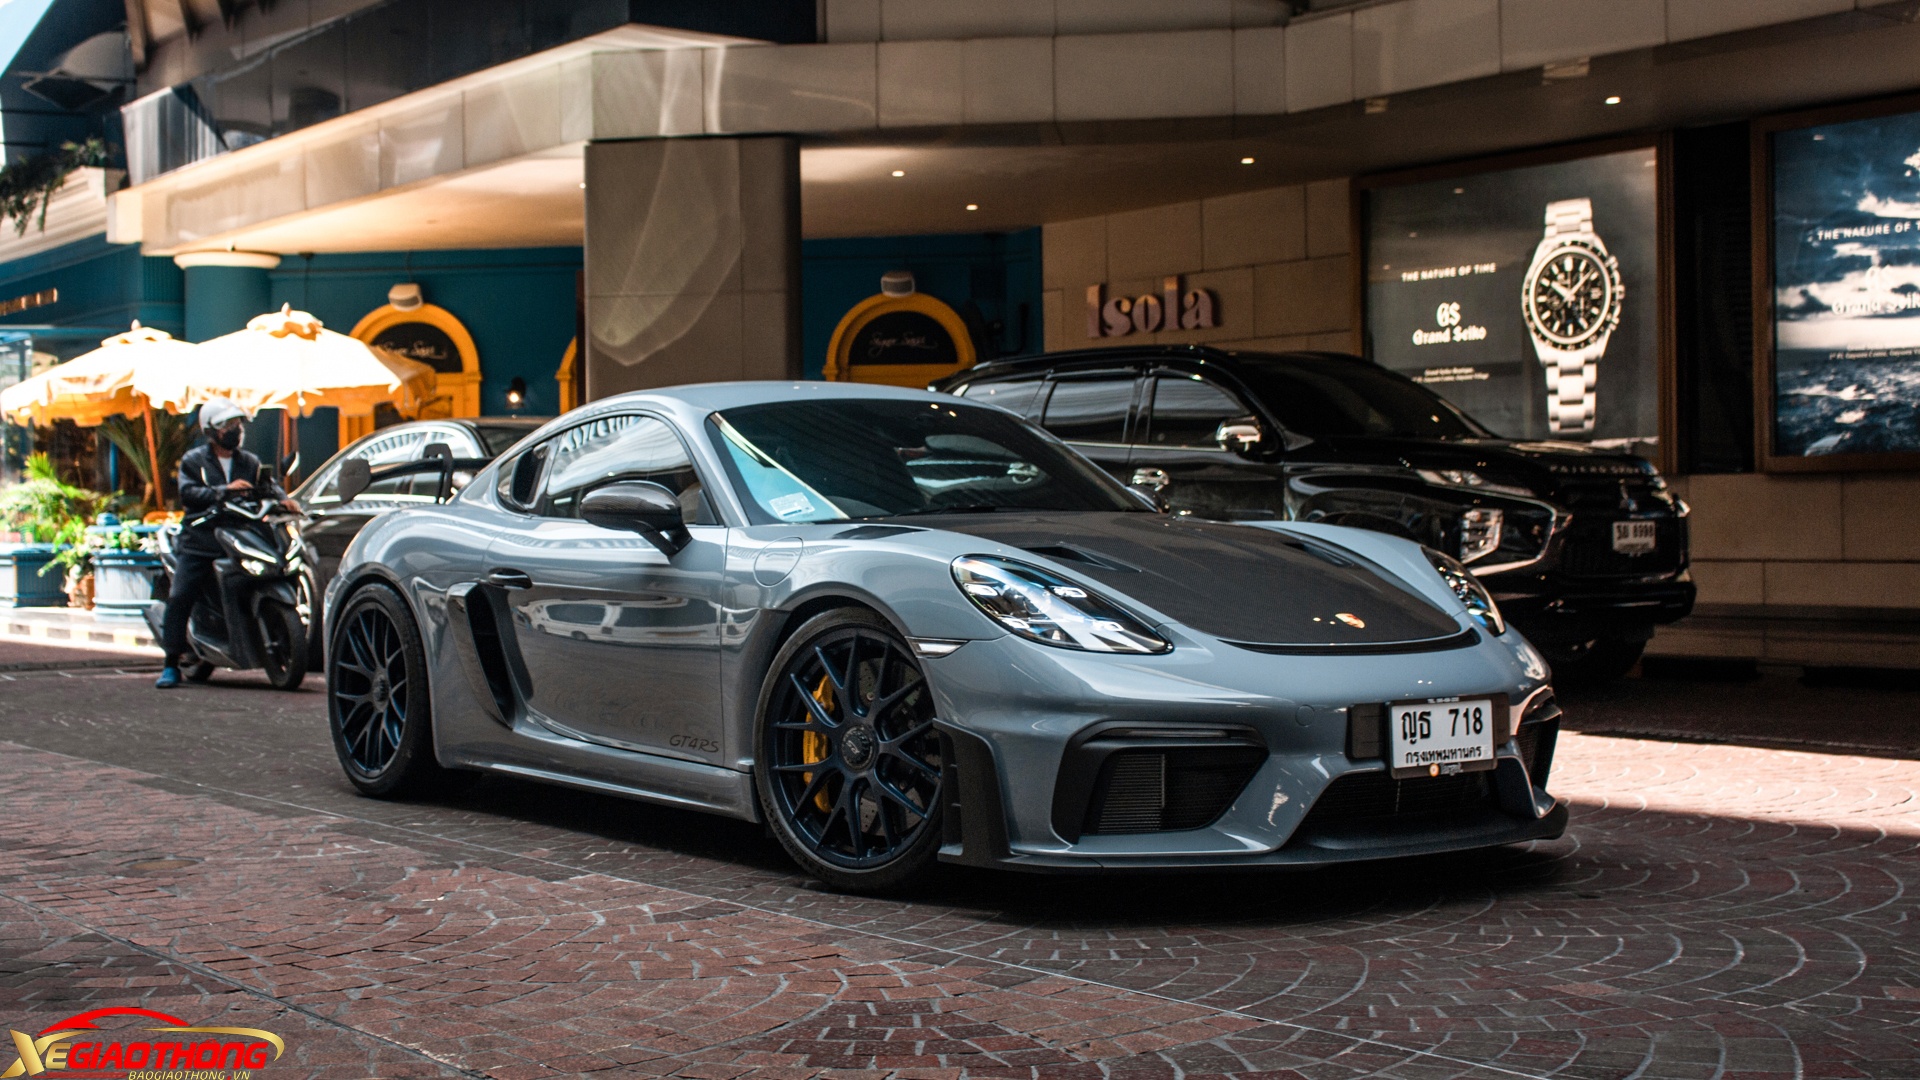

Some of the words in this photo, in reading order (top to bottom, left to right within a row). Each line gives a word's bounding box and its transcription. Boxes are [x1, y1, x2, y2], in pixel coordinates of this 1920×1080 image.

[1817, 229, 1839, 241] THE
[1894, 221, 1911, 233] OF
[1401, 271, 1419, 282] THE
[1420, 266, 1456, 280] NATURE
[1458, 264, 1472, 276] OF
[1474, 262, 1496, 274] TIME
[1086, 275, 1214, 338] Isola
[1436, 301, 1461, 327] GS
[1412, 327, 1451, 345] Grand
[1452, 325, 1487, 342] Seiko
[1401, 710, 1431, 744] ญธ
[1448, 707, 1483, 737] 718
[669, 734, 719, 753] GT4RS
[1405, 745, 1482, 767] กรุงเทพมหานคร
